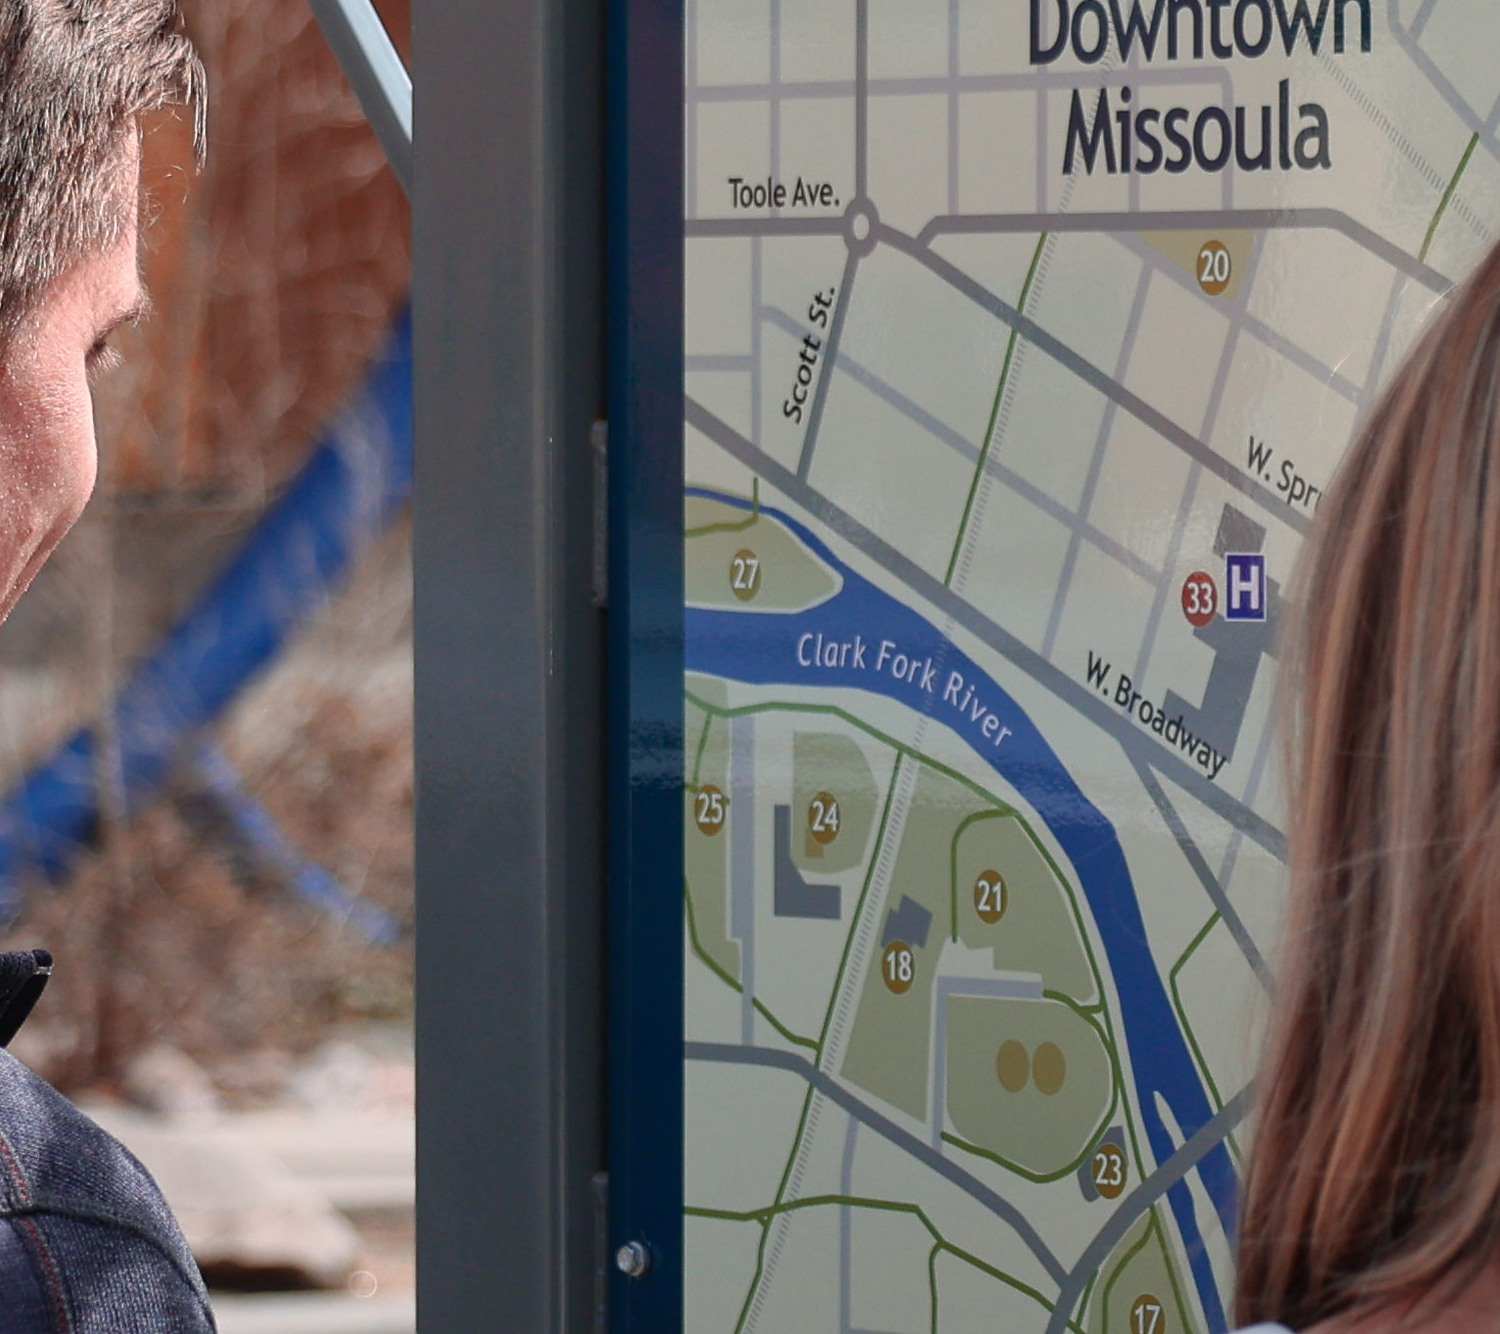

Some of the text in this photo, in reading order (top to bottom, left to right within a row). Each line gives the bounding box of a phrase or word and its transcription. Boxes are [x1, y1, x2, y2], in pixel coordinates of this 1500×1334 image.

[1062, 77, 1332, 175] Missoula
[728, 175, 841, 208] Toole Ave.
[1200, 249, 1229, 282] 20
[782, 286, 836, 425] Scott St.
[1247, 434, 1274, 482] W.
[733, 557, 760, 590] 27
[1230, 564, 1261, 611] H
[1186, 581, 1214, 616] 33
[797, 631, 1013, 747] Clark Fork River
[1086, 649, 1228, 781] W. Broadway
[697, 792, 724, 825] 25
[811, 800, 840, 833] 24
[977, 879, 1003, 912] 21
[886, 950, 912, 983] 18
[1094, 1152, 1123, 1186] 23
